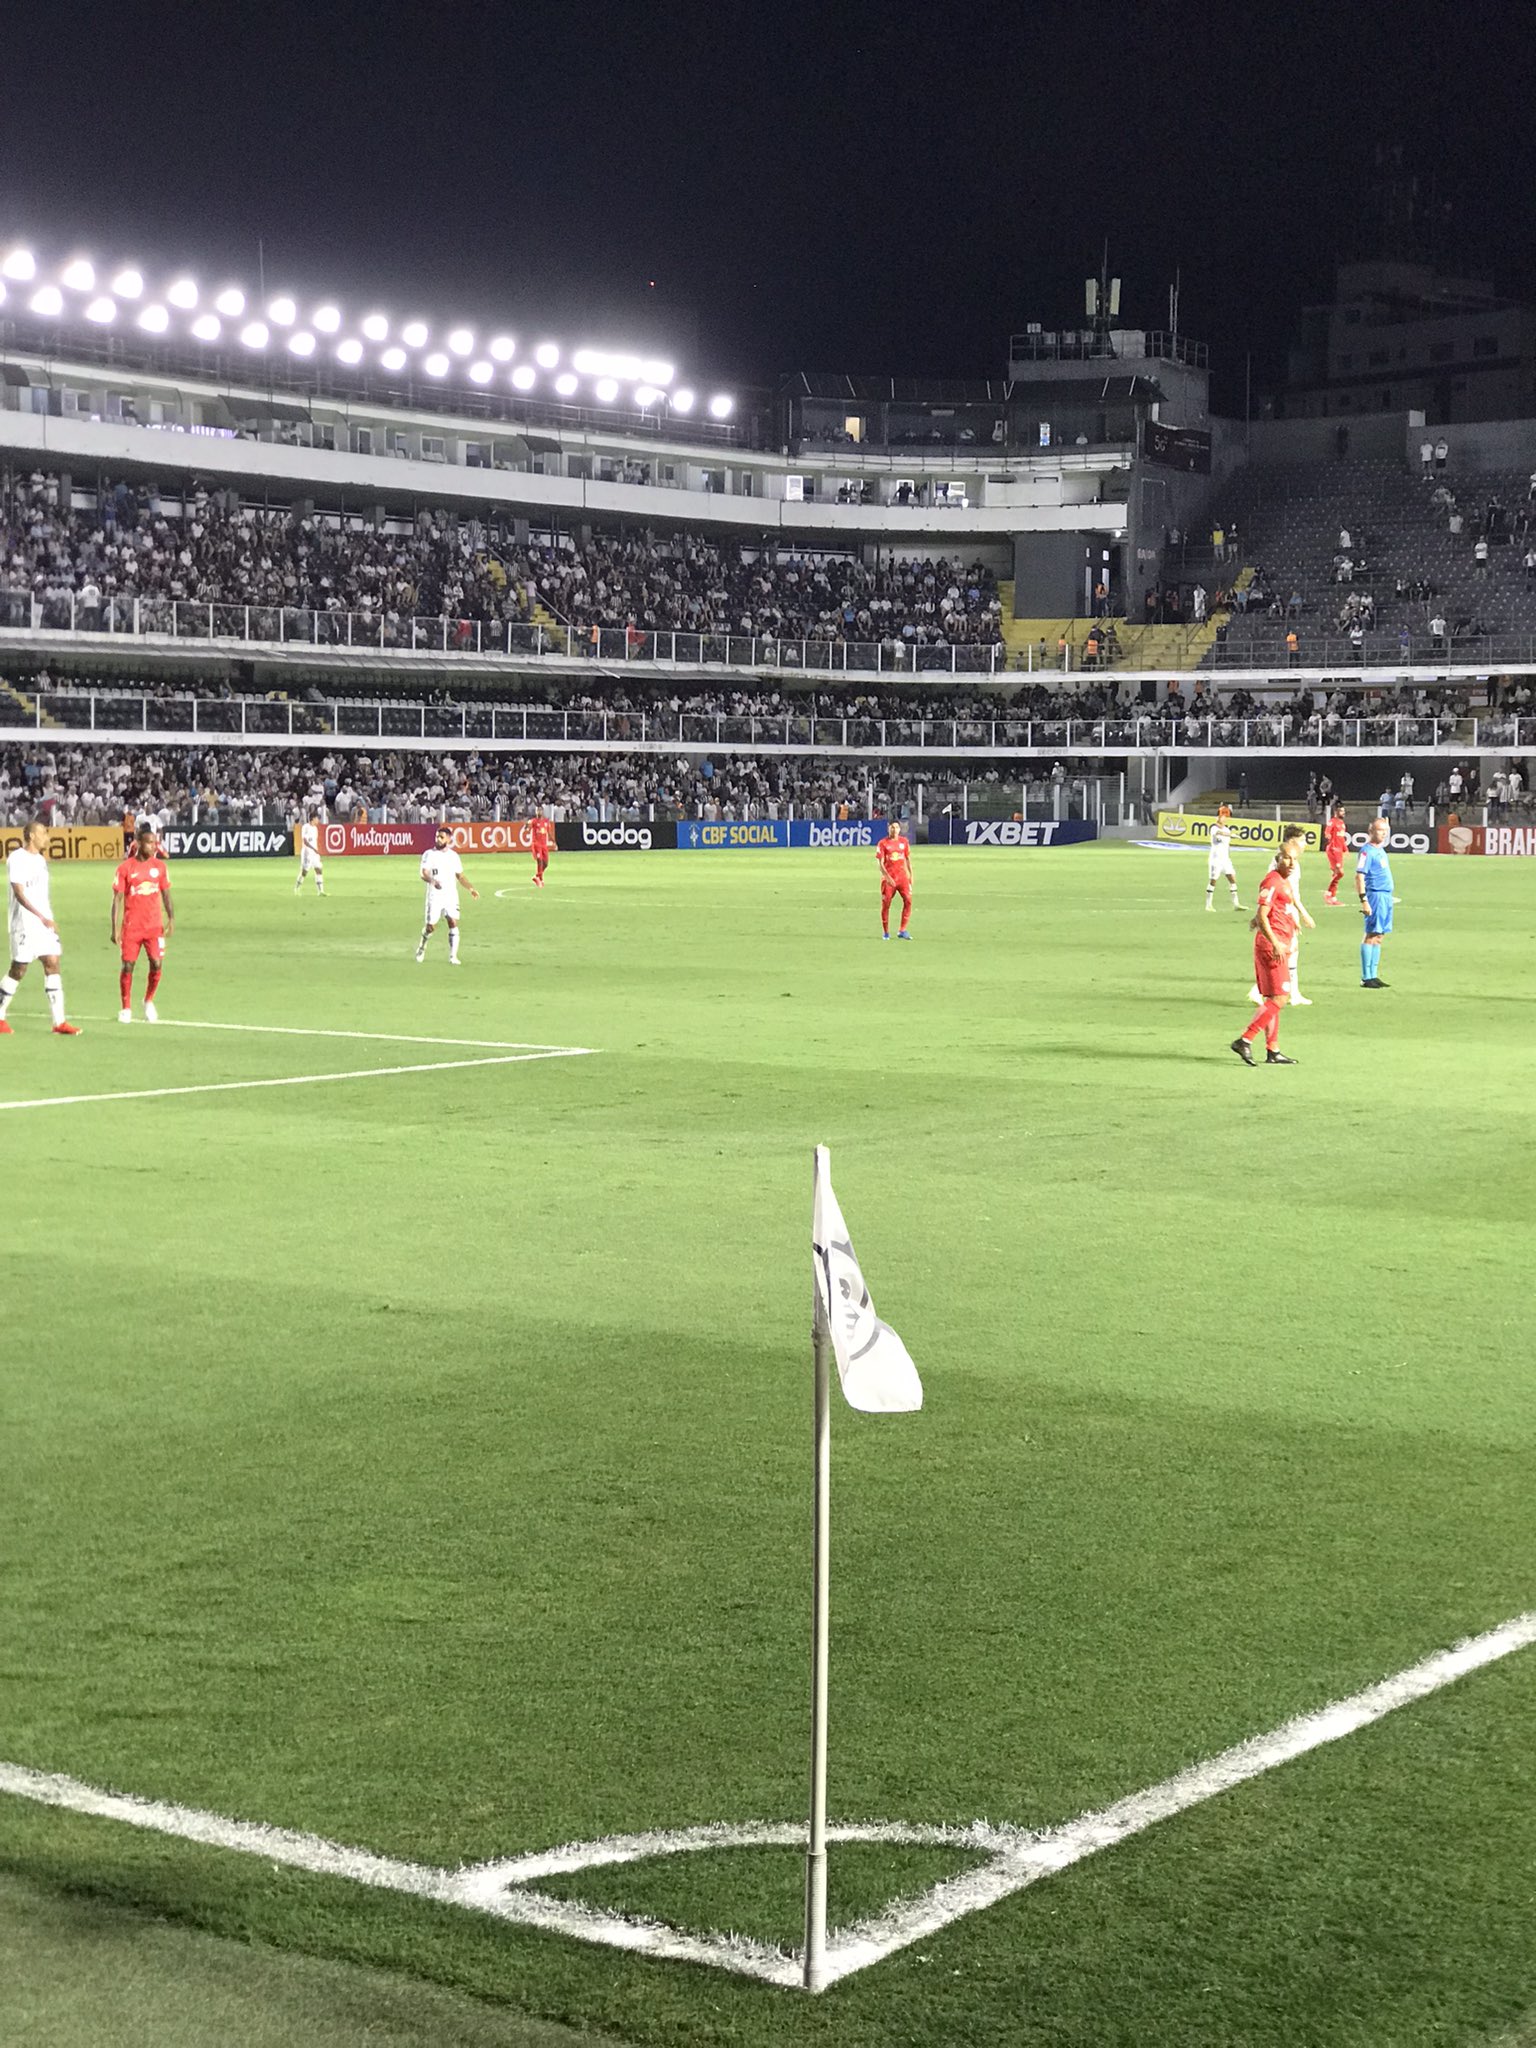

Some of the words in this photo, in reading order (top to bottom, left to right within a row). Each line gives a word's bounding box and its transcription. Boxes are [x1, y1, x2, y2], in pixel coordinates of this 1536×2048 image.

[197, 831, 286, 853] OLIVEIRA
[350, 827, 414, 855] Instagram
[481, 826, 517, 848] GOL
[583, 821, 652, 850] bodog
[702, 825, 728, 845] CBF
[729, 825, 778, 845] SOCIAL
[809, 821, 872, 847] betcris
[965, 821, 1060, 846] 1XBET
[1191, 821, 1274, 842] mcado
[1485, 827, 1536, 855] BRAH
